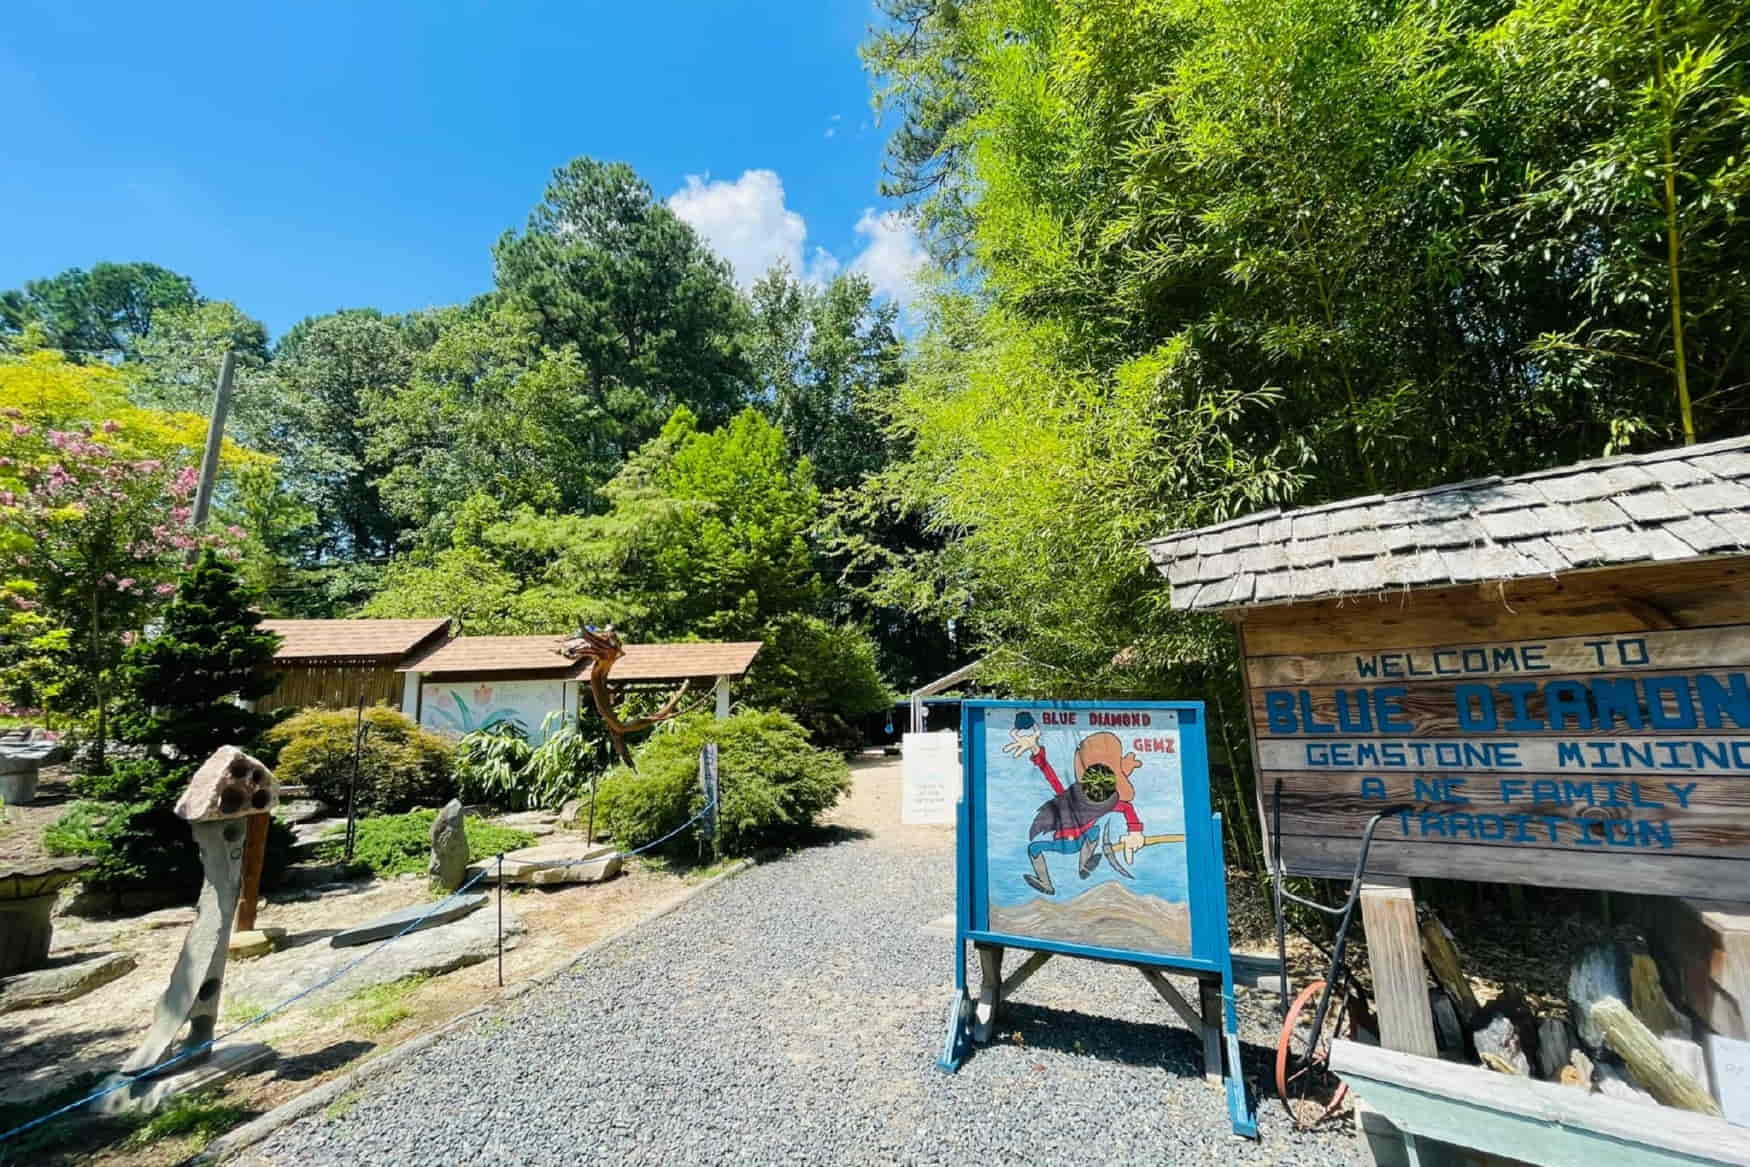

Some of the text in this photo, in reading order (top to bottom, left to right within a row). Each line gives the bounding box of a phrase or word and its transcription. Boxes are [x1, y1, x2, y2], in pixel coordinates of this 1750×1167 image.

[1356, 638, 1649, 678] WELCOME TO
[1042, 711, 1151, 726] BLUE DIAMOND
[1265, 687, 1415, 734] BLUE
[1133, 738, 1176, 753] GEMZ
[1306, 743, 1523, 767] GEMSTONE
[1361, 777, 1386, 800] A
[1502, 778, 1697, 809] FAMILY
[1399, 808, 1674, 848] TRADITION
